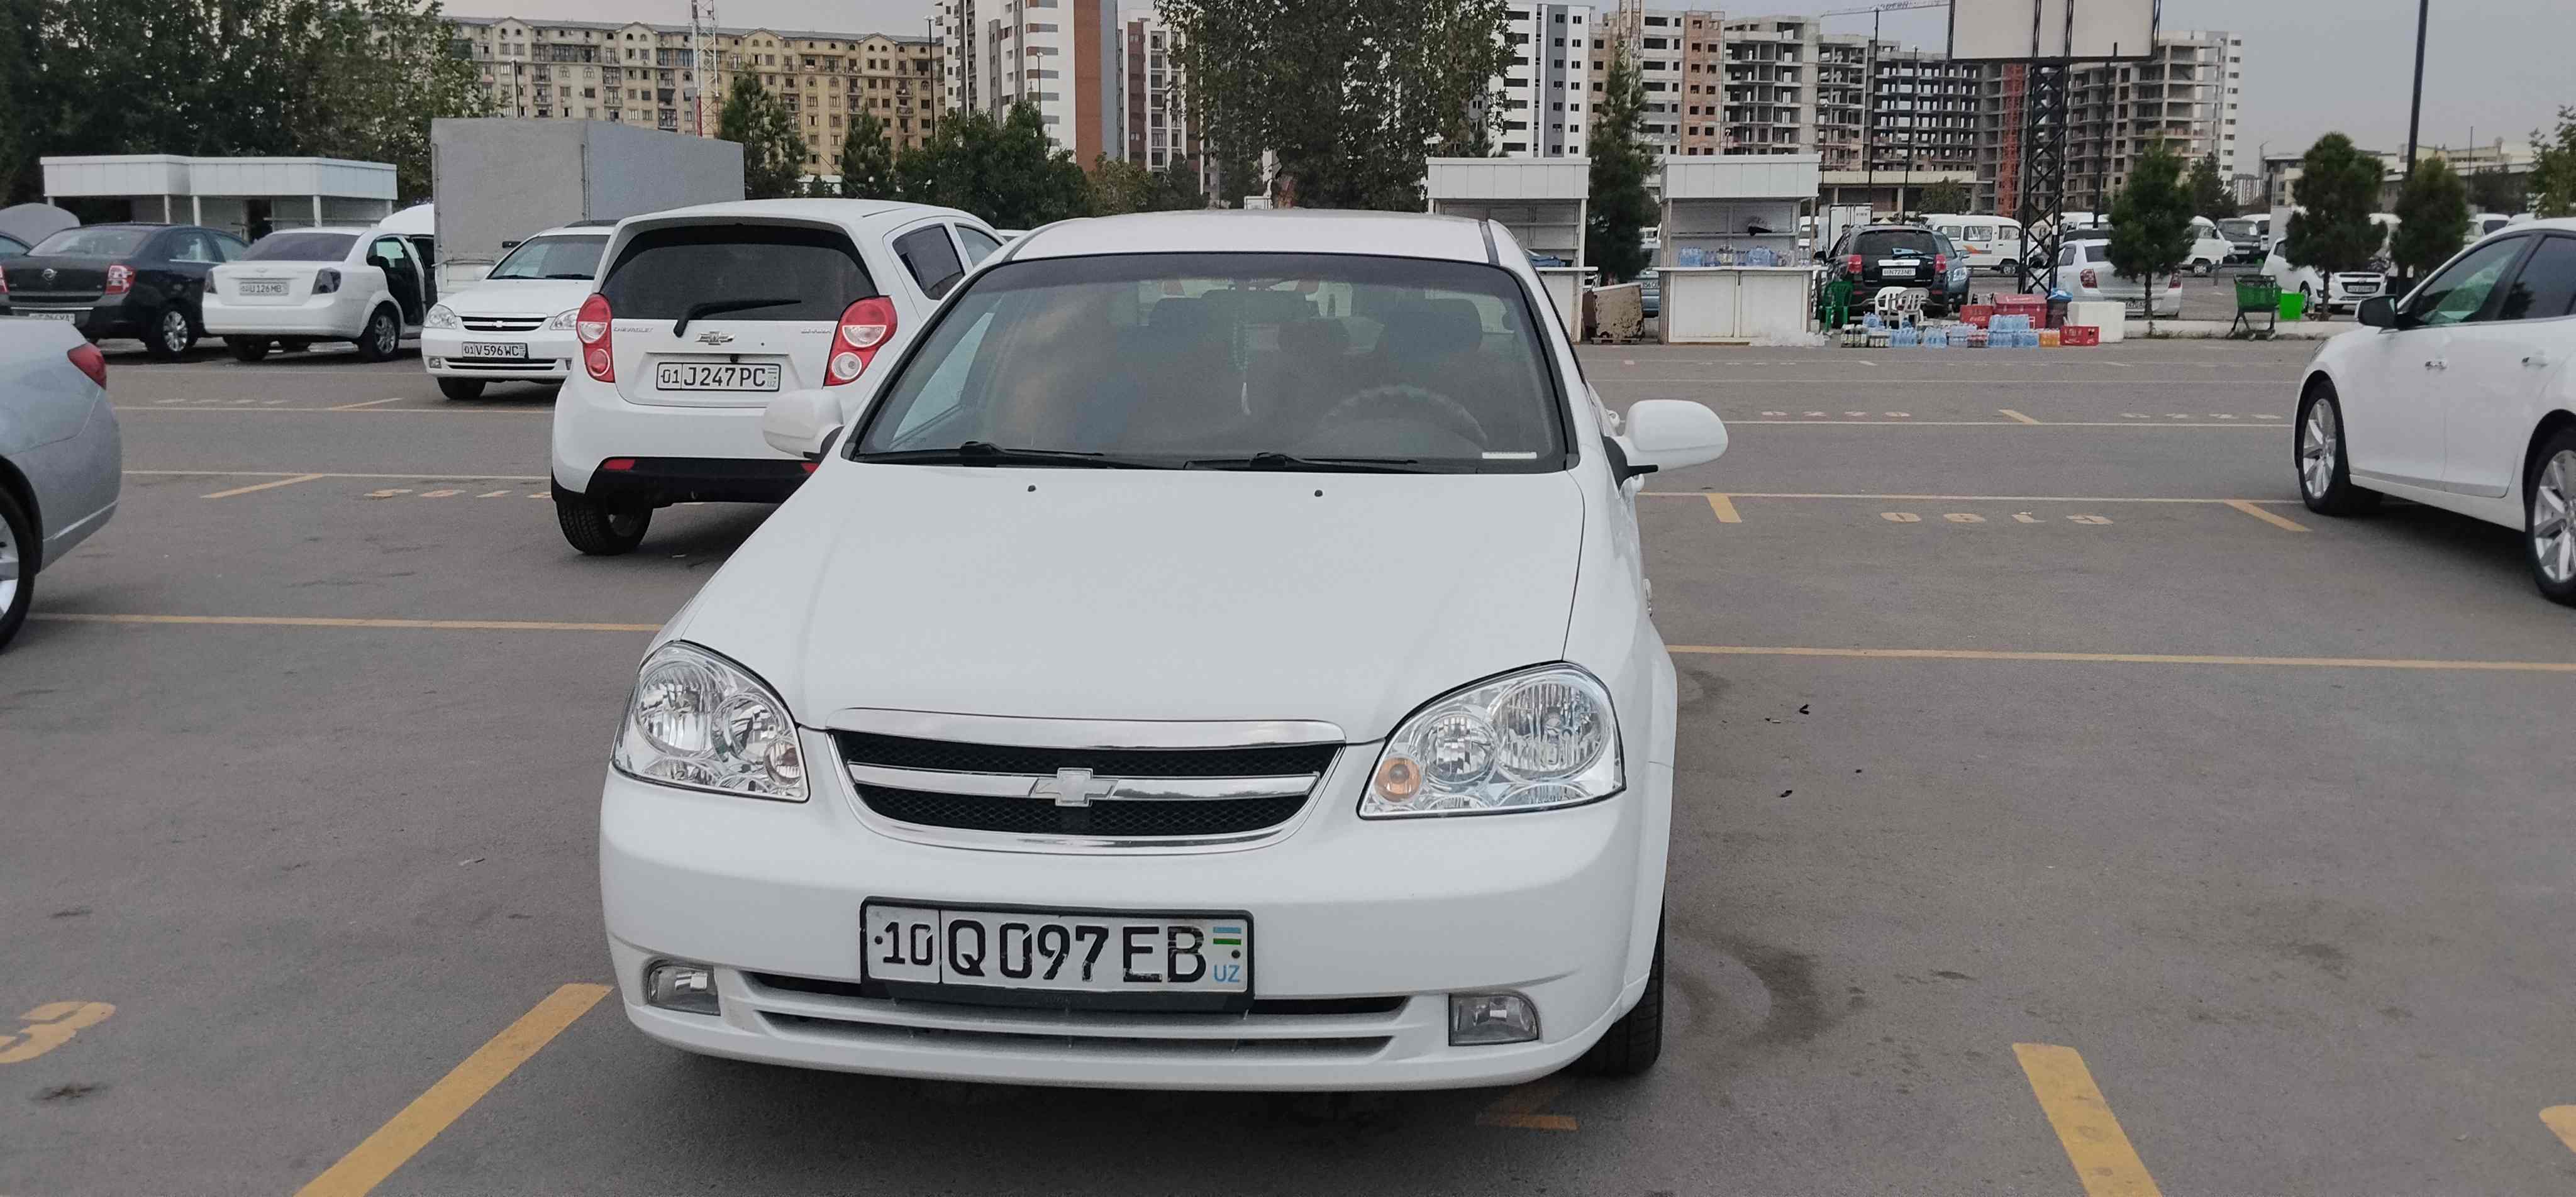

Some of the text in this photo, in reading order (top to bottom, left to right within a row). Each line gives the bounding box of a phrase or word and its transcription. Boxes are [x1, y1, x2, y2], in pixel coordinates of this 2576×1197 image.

[475, 345, 519, 356] V596WC
[662, 367, 766, 387] 01 J247PC
[882, 918, 1207, 983] 10 Q097EB
[1213, 965, 1241, 983] UZ
